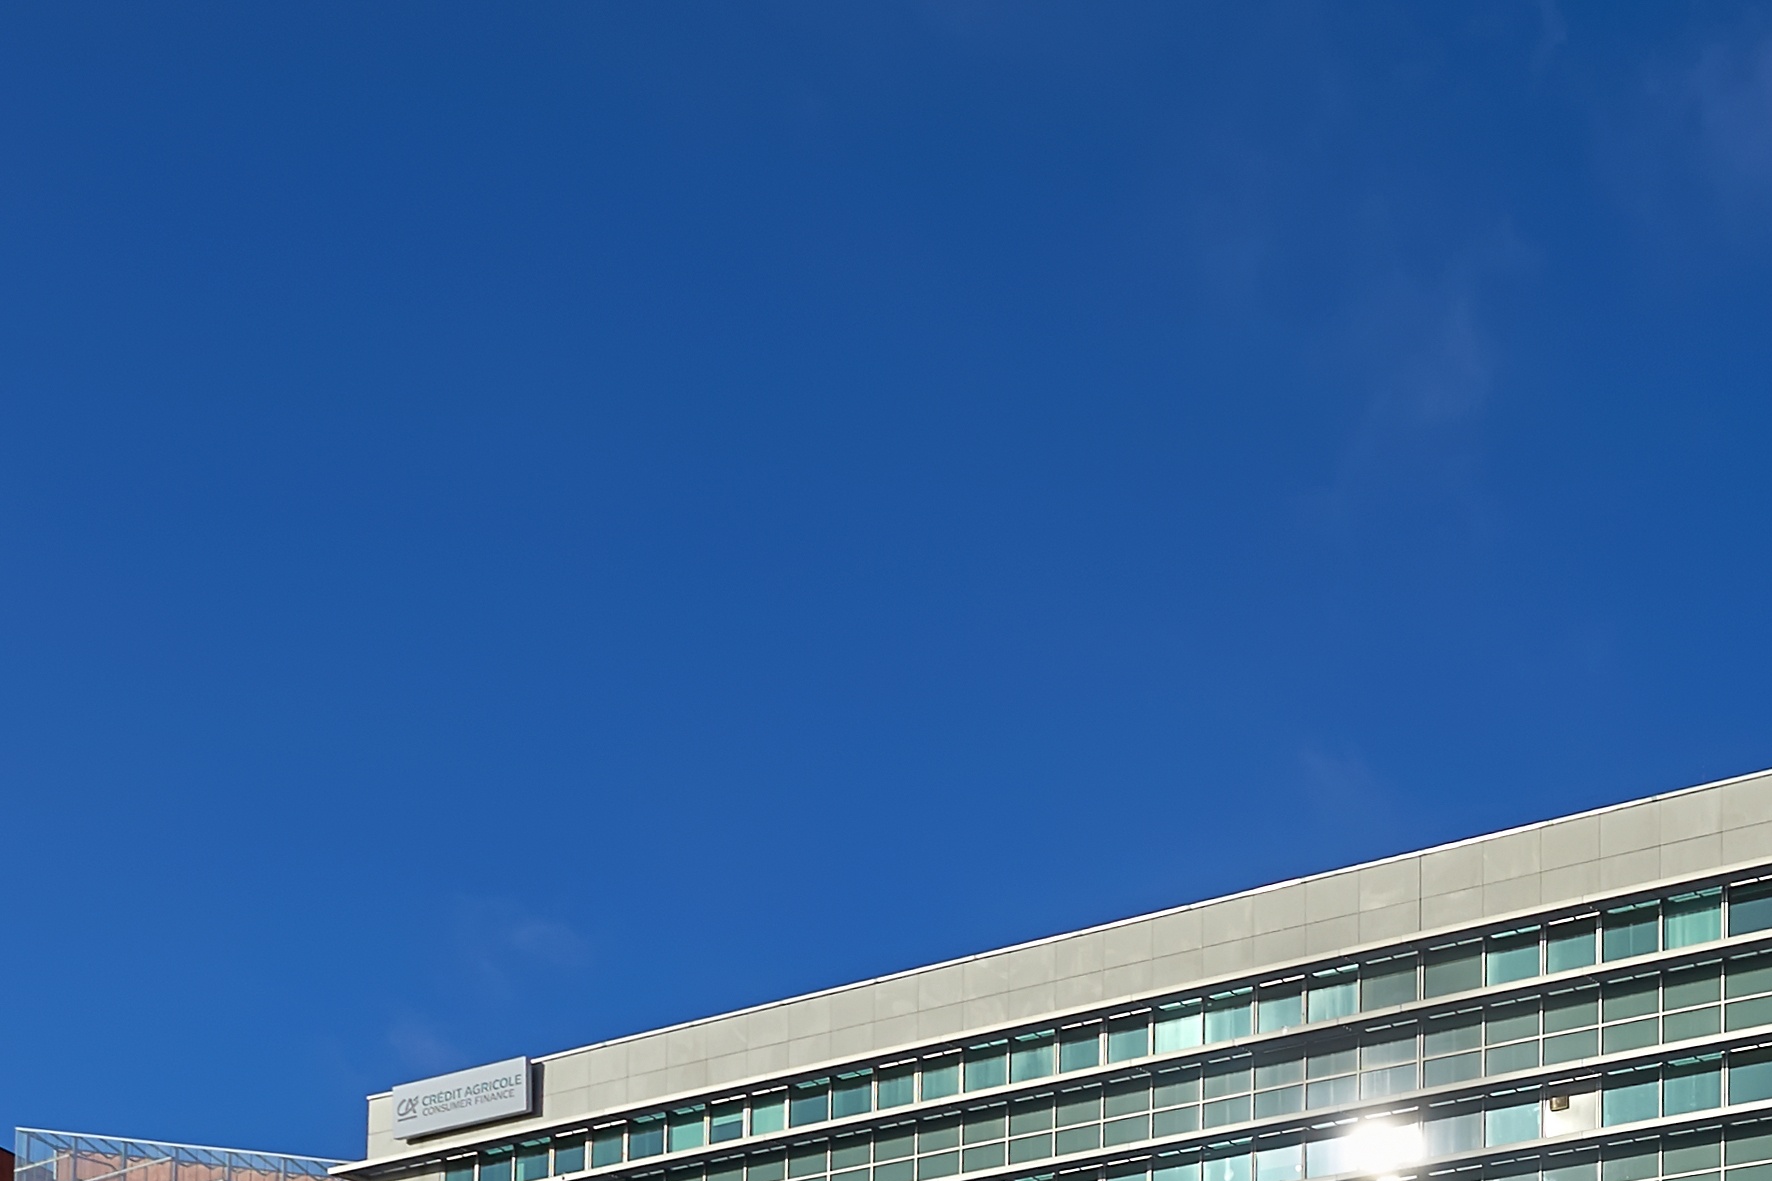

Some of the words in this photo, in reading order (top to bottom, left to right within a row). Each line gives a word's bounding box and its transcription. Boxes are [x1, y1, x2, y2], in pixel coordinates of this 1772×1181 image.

[422, 1088, 463, 1107] CRÉDIT
[464, 1074, 522, 1096] AGRICOLE
[422, 1099, 473, 1117] CONSUMER
[474, 1088, 516, 1105] FINANCE
